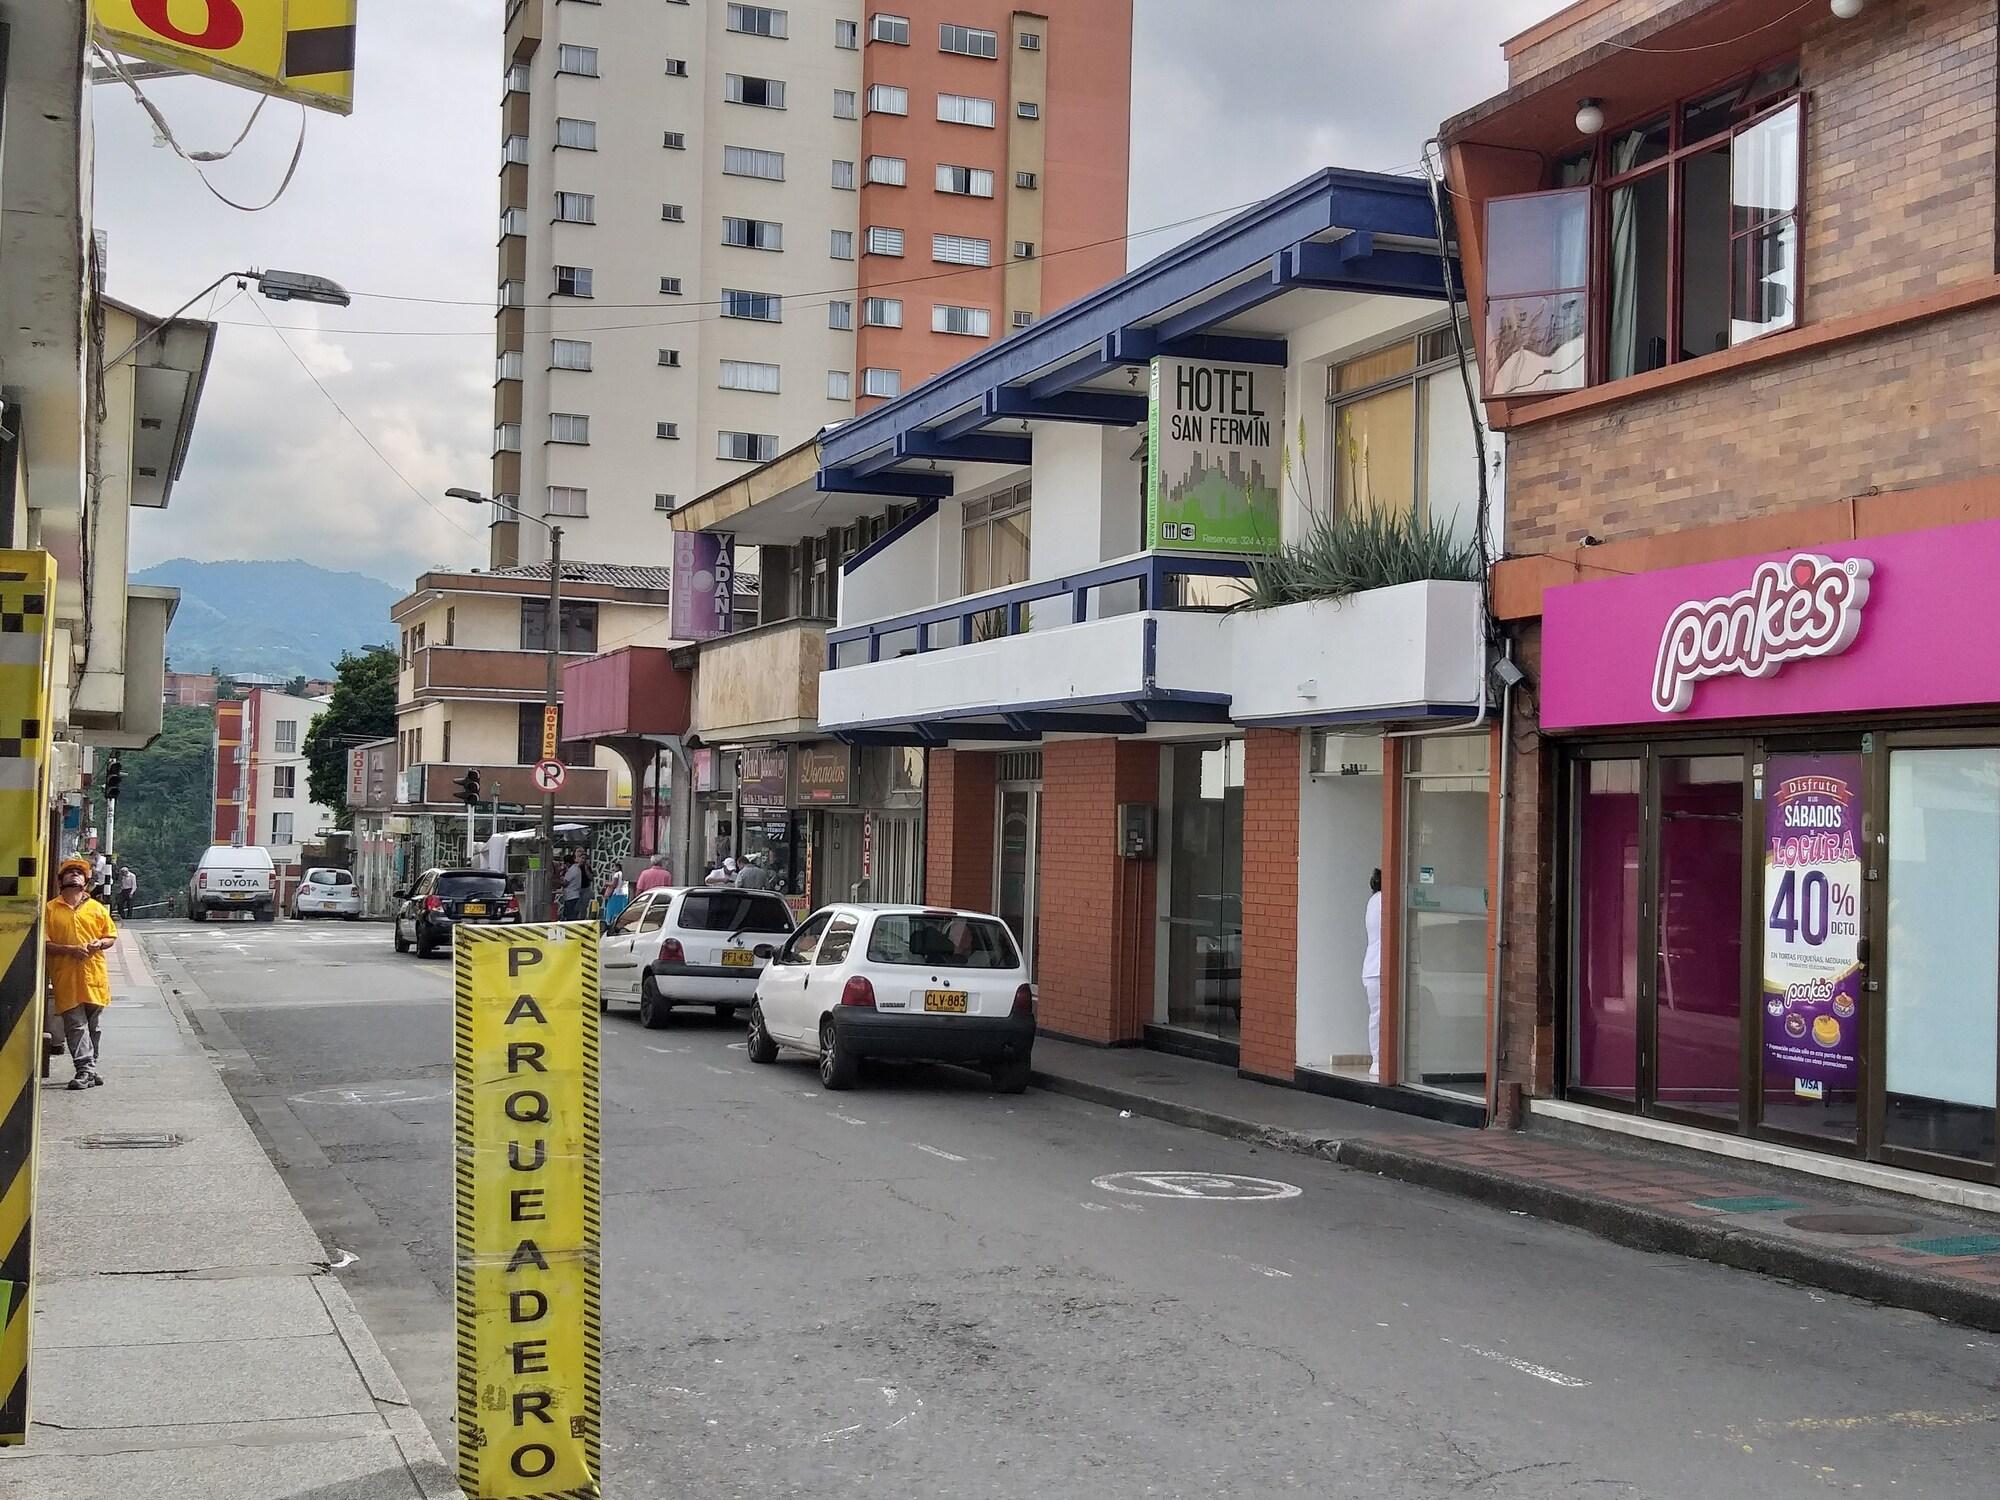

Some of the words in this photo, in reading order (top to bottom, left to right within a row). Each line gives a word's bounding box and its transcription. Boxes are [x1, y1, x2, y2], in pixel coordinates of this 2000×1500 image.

[1176, 365, 1265, 417] HOTEL
[1171, 414, 1202, 442] SAN
[1209, 416, 1270, 447] FERMÍN
[677, 532, 694, 628] HOTEL
[714, 534, 731, 630] YADANI
[545, 707, 557, 748] MOTOS
[353, 752, 364, 793] HOTEL
[1789, 779, 1838, 793] Disfruta
[1785, 800, 1842, 828] SÁBADOS
[1772, 830, 1856, 868] LOCURA
[218, 879, 260, 887] TOYOTA
[1831, 921, 1858, 936] DCTO.
[1779, 952, 1797, 961] TORTAS
[1825, 957, 1852, 965] MEDIANAS
[1799, 1077, 1820, 1091] VISA
[504, 947, 556, 1478] PARQUEADERO
